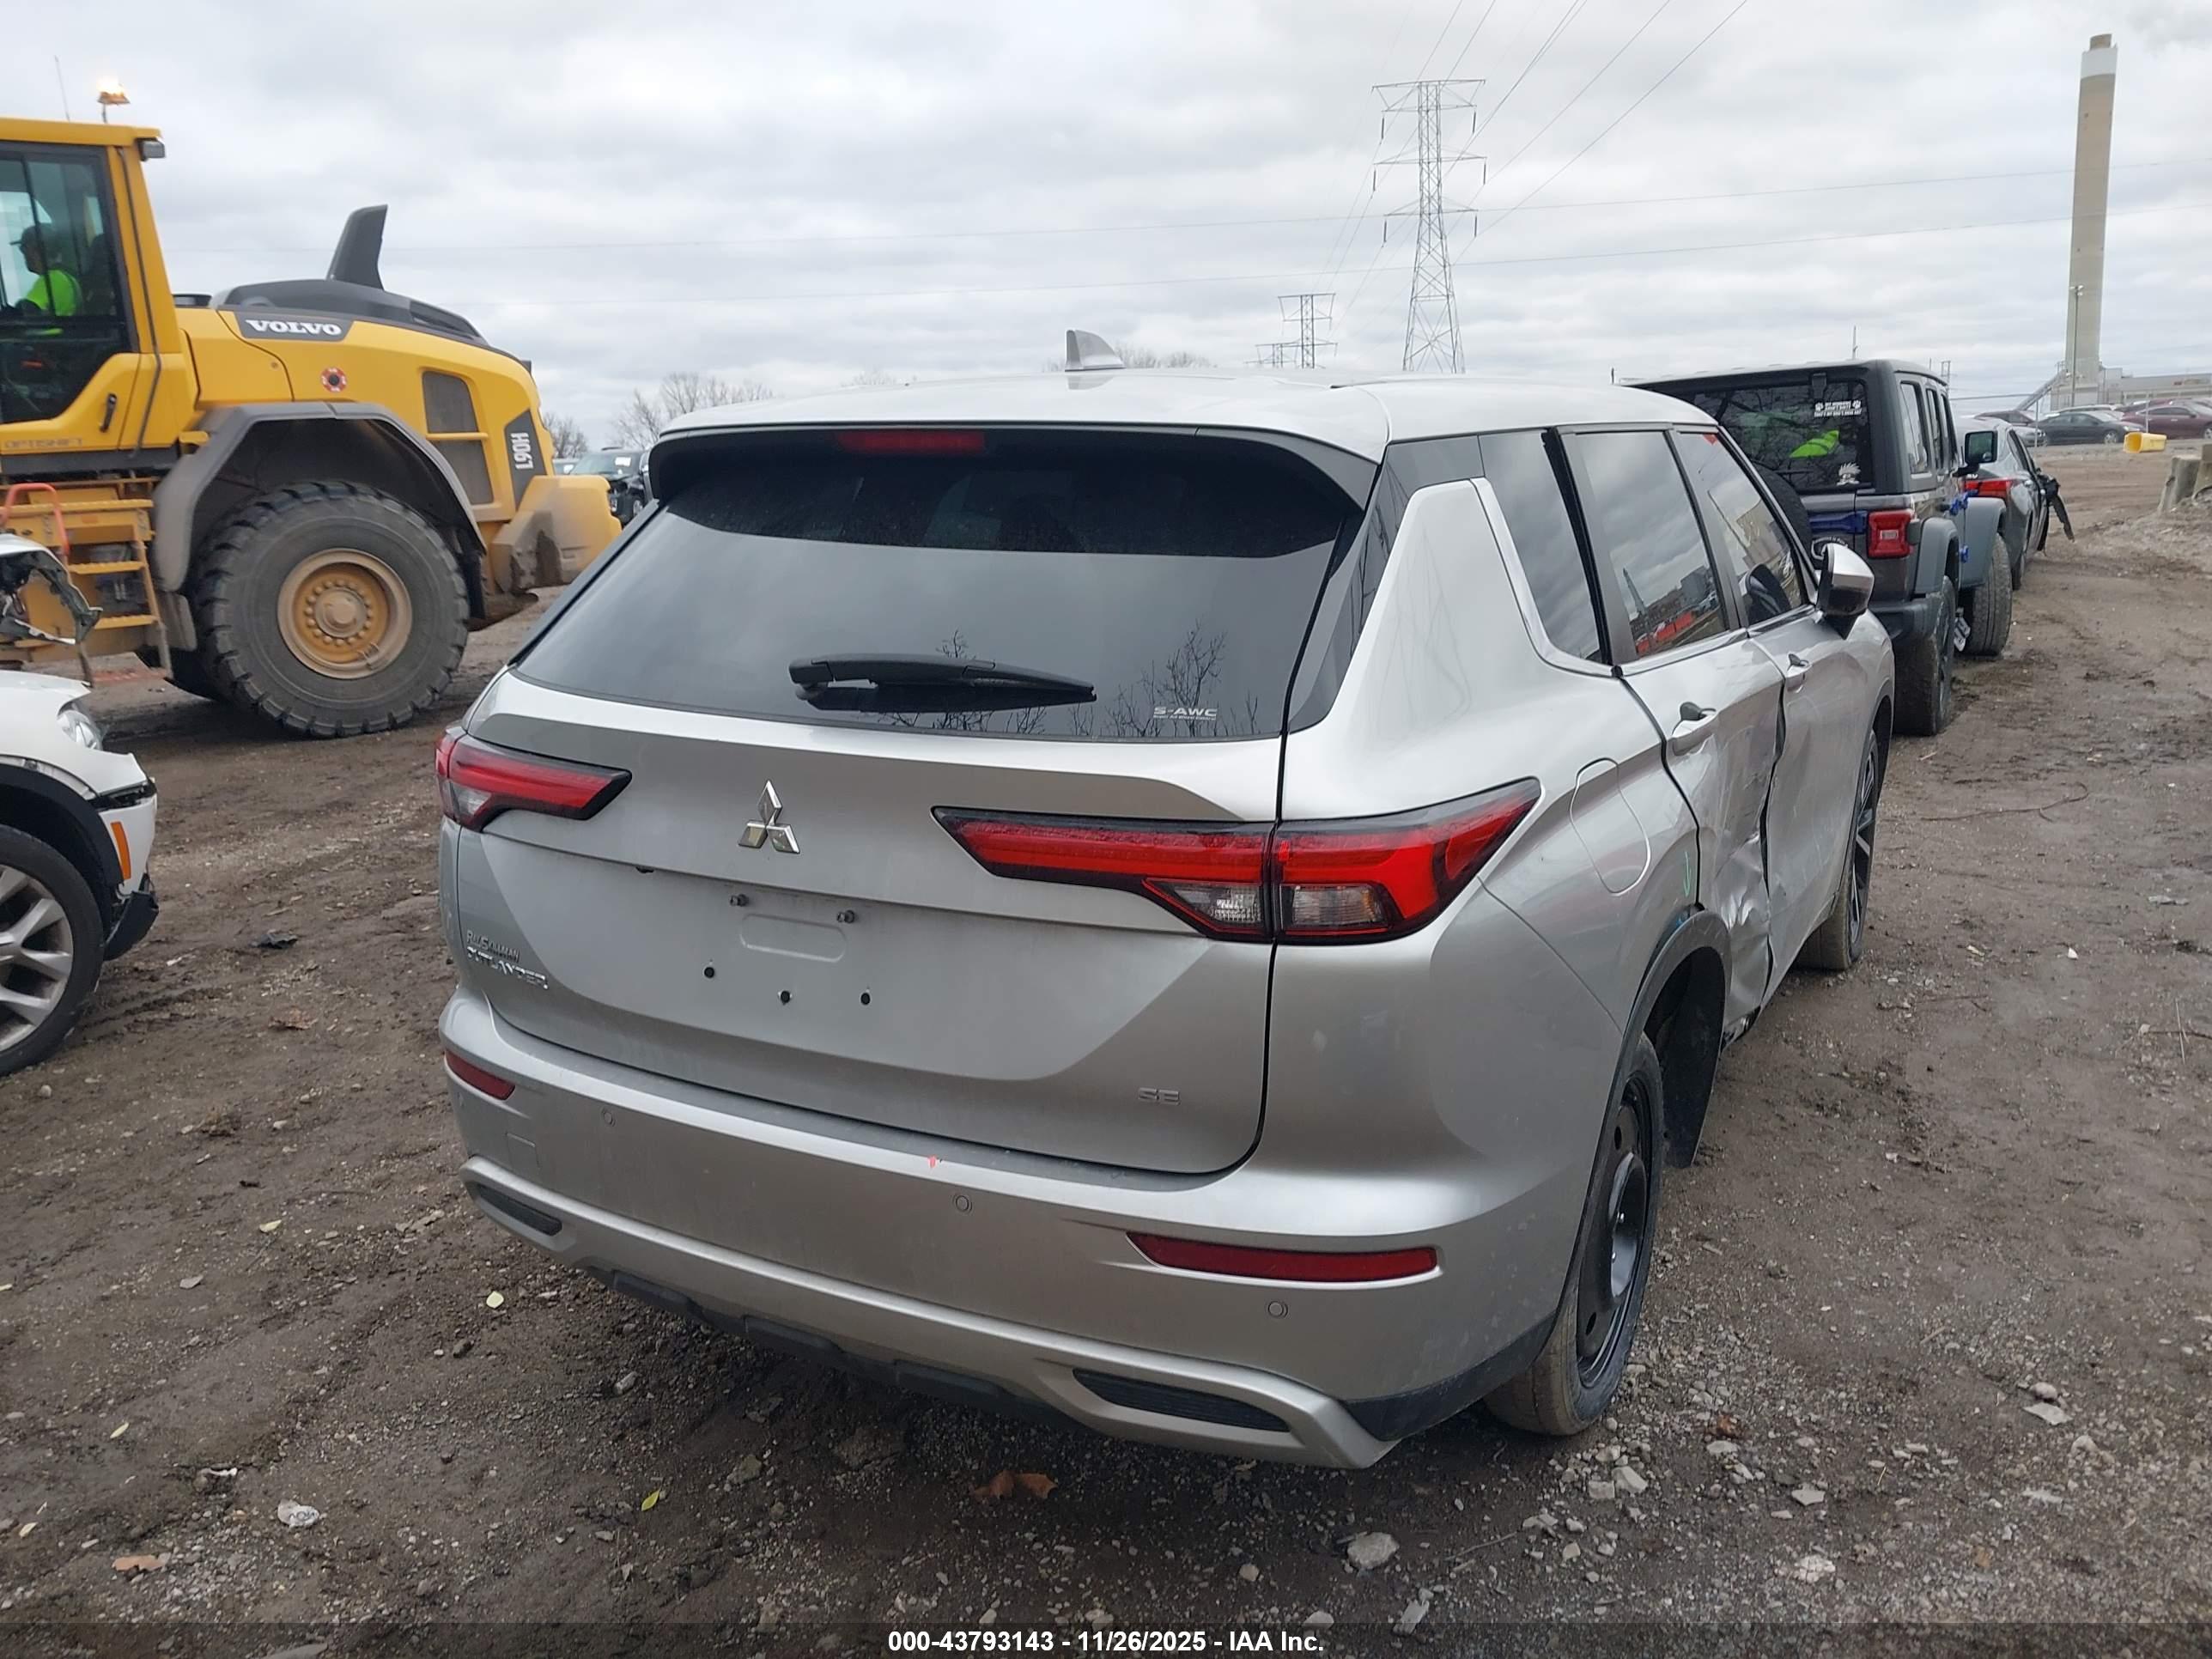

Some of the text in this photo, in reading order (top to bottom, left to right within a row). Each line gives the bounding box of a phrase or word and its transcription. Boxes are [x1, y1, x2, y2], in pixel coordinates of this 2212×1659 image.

[245, 319, 342, 336] VOLVO
[510, 432, 533, 469] L90H
[1153, 706, 1218, 717] S-AWC
[1138, 1086, 1180, 1106] SE
